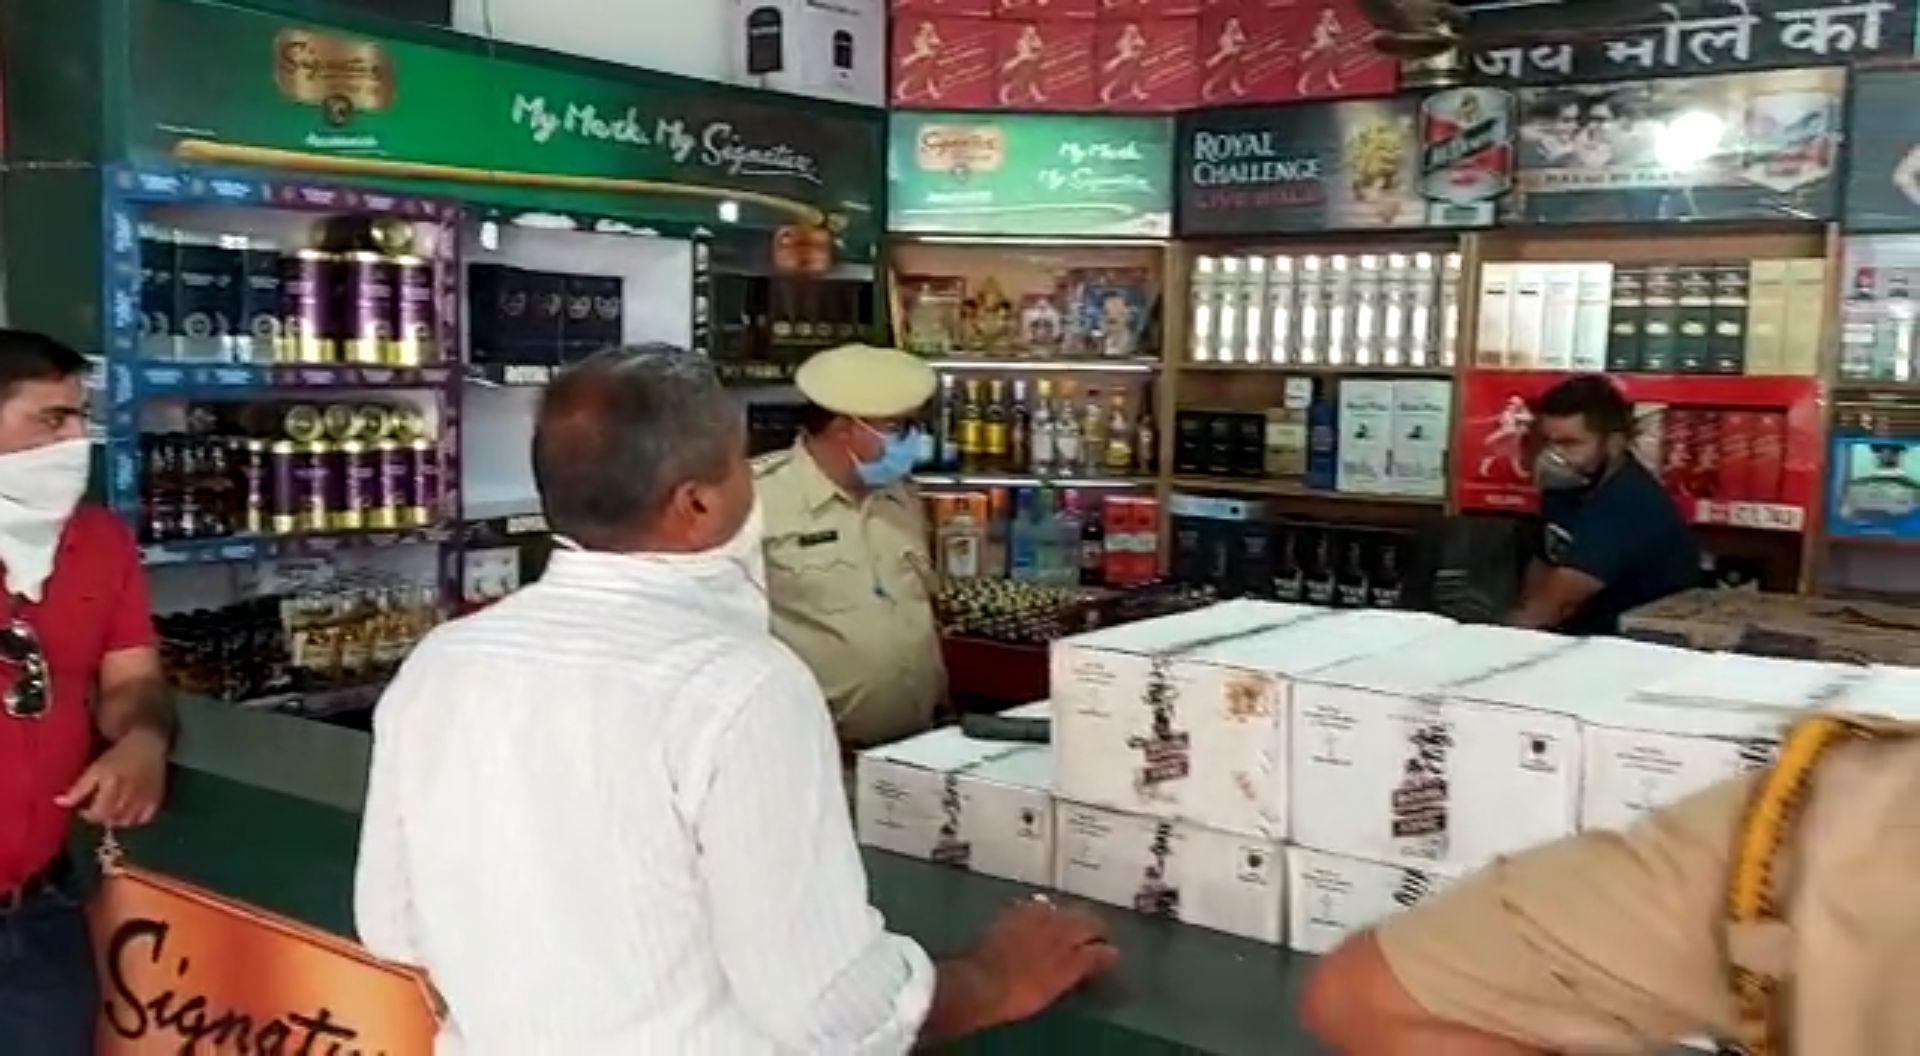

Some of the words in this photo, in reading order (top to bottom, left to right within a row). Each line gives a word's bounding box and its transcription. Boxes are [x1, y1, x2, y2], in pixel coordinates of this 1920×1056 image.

[1473, 43, 1573, 78] जय
[512, 93, 560, 143] My
[656, 118, 694, 163] My
[1193, 130, 1277, 162] ROYAL
[1192, 157, 1323, 186] CHALLENGE
